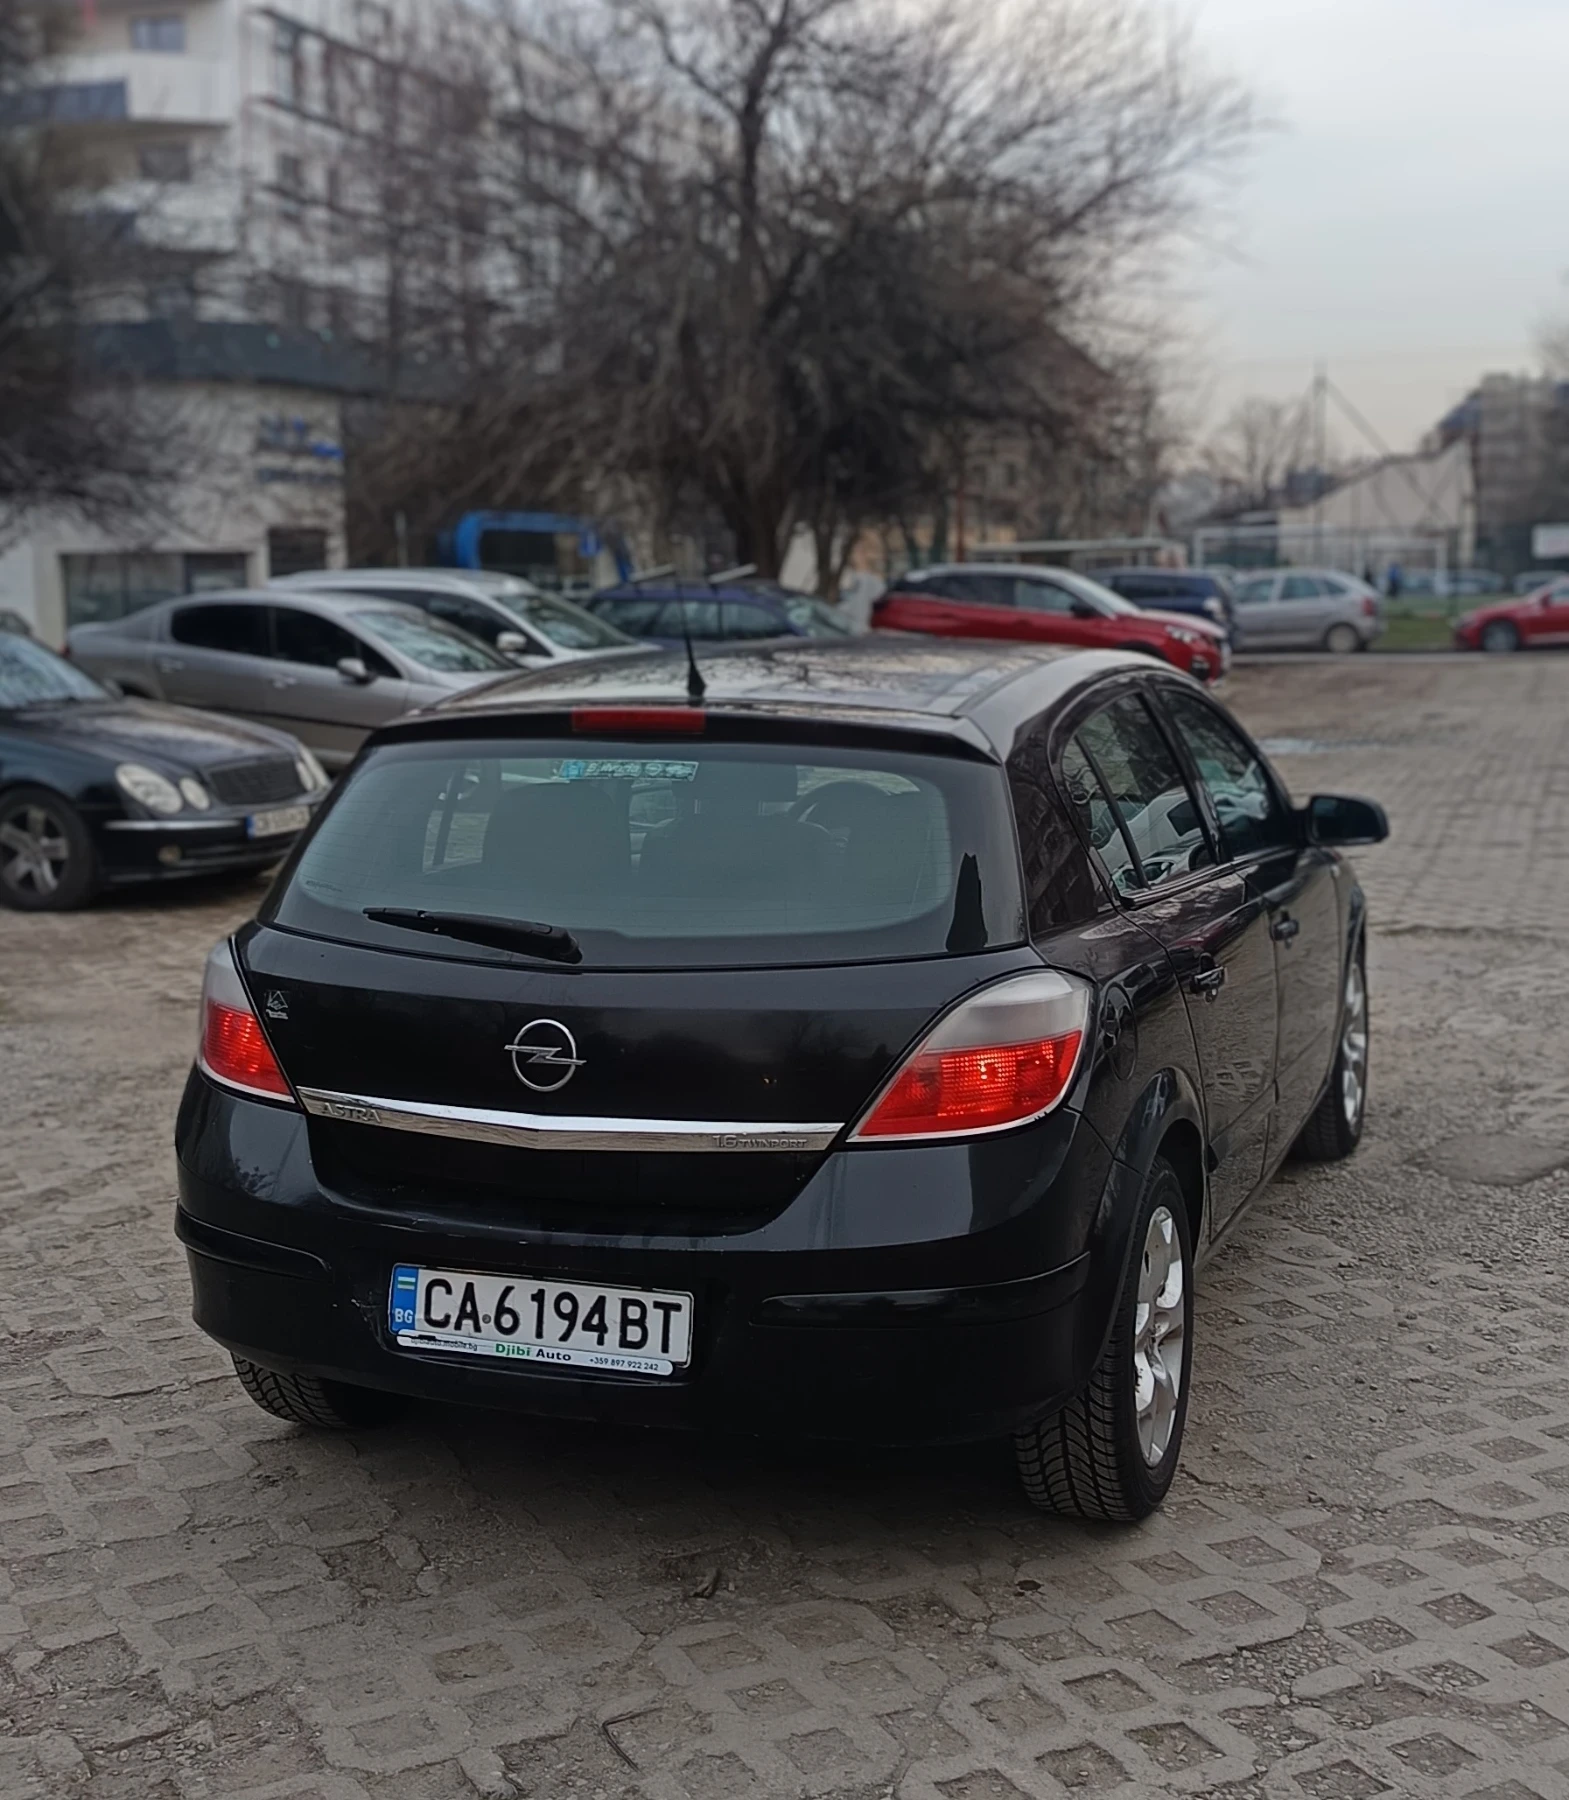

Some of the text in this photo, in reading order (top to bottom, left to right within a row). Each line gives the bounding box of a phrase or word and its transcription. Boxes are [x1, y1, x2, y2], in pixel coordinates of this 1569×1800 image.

[321, 1102, 381, 1123] ASTRA
[712, 1135, 807, 1149] 1.6 TWINPORT
[394, 1307, 414, 1324] BG
[495, 1343, 572, 1362] Djibi Auto
[589, 1356, 659, 1372] +359 897 922 242
